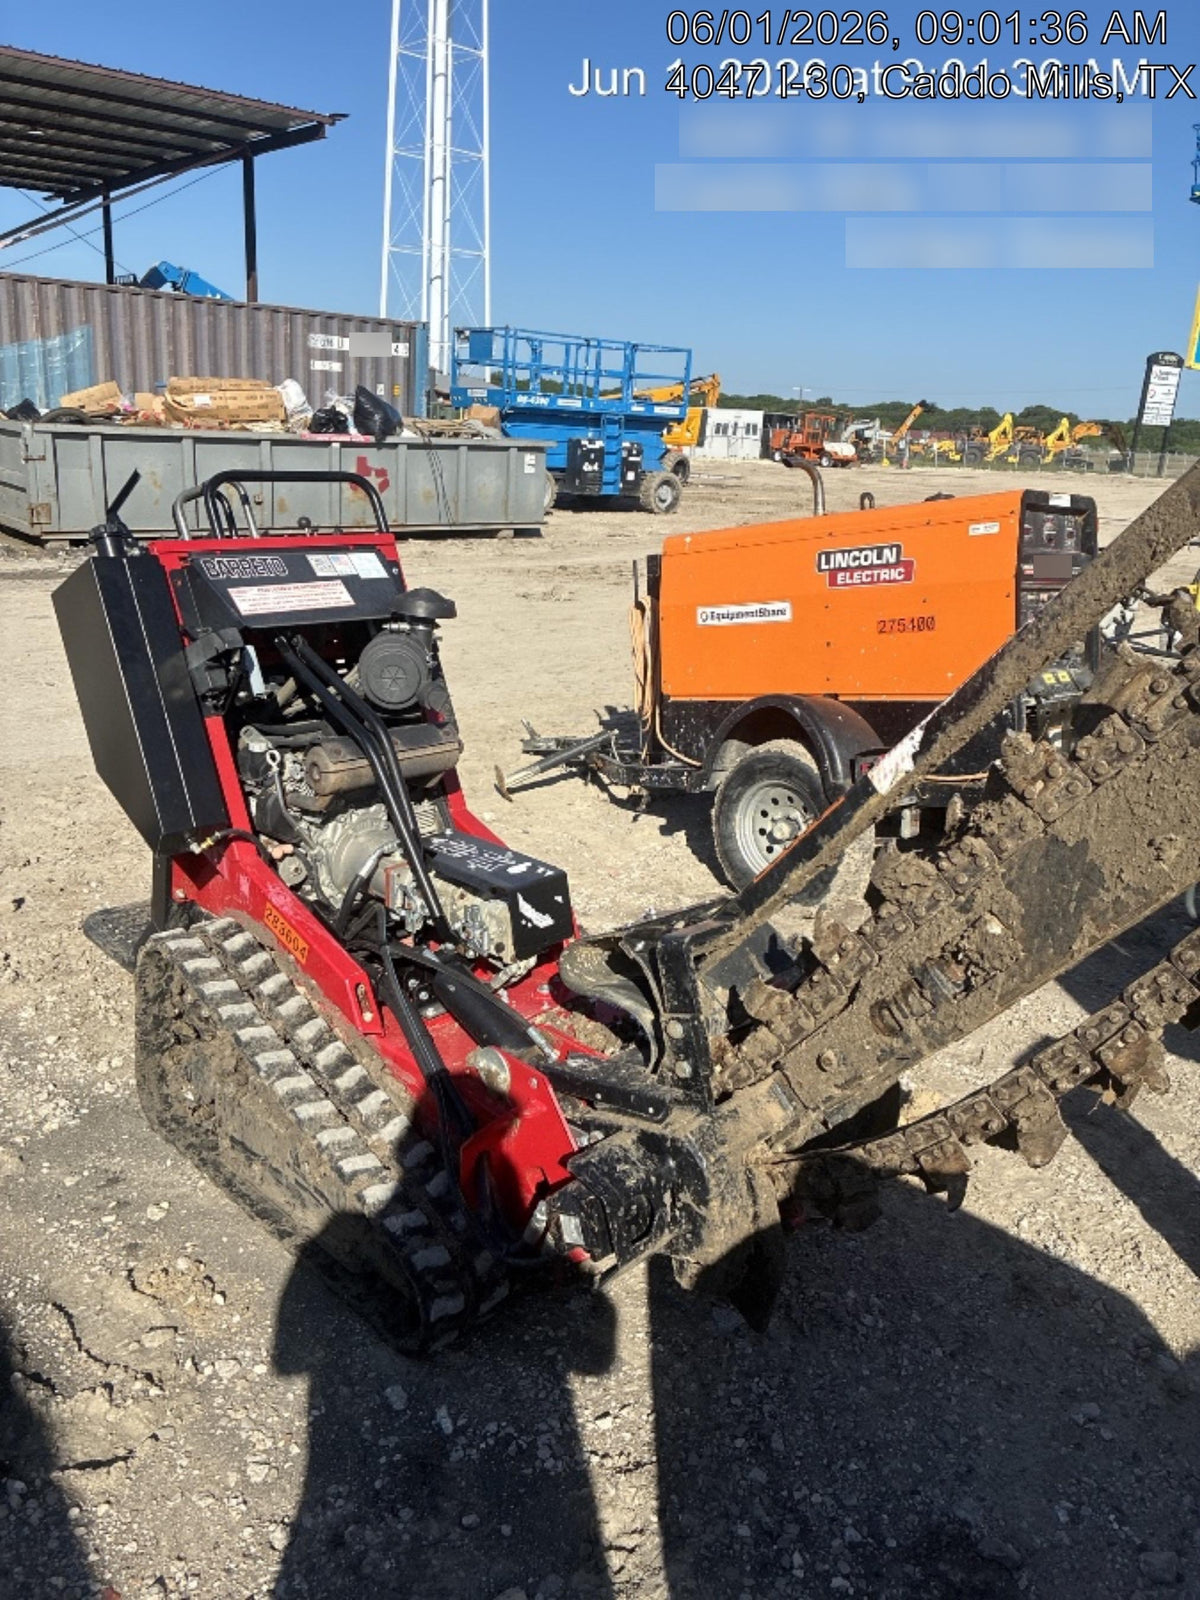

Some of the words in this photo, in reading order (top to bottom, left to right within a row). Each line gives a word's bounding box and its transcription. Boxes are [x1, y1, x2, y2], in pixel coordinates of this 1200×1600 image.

[200, 555, 289, 580] BARRETO
[820, 546, 898, 570] LINCOLN
[836, 567, 906, 585] ELECTRIC
[709, 607, 788, 622] EquipmentShare
[265, 906, 308, 960] 283604
